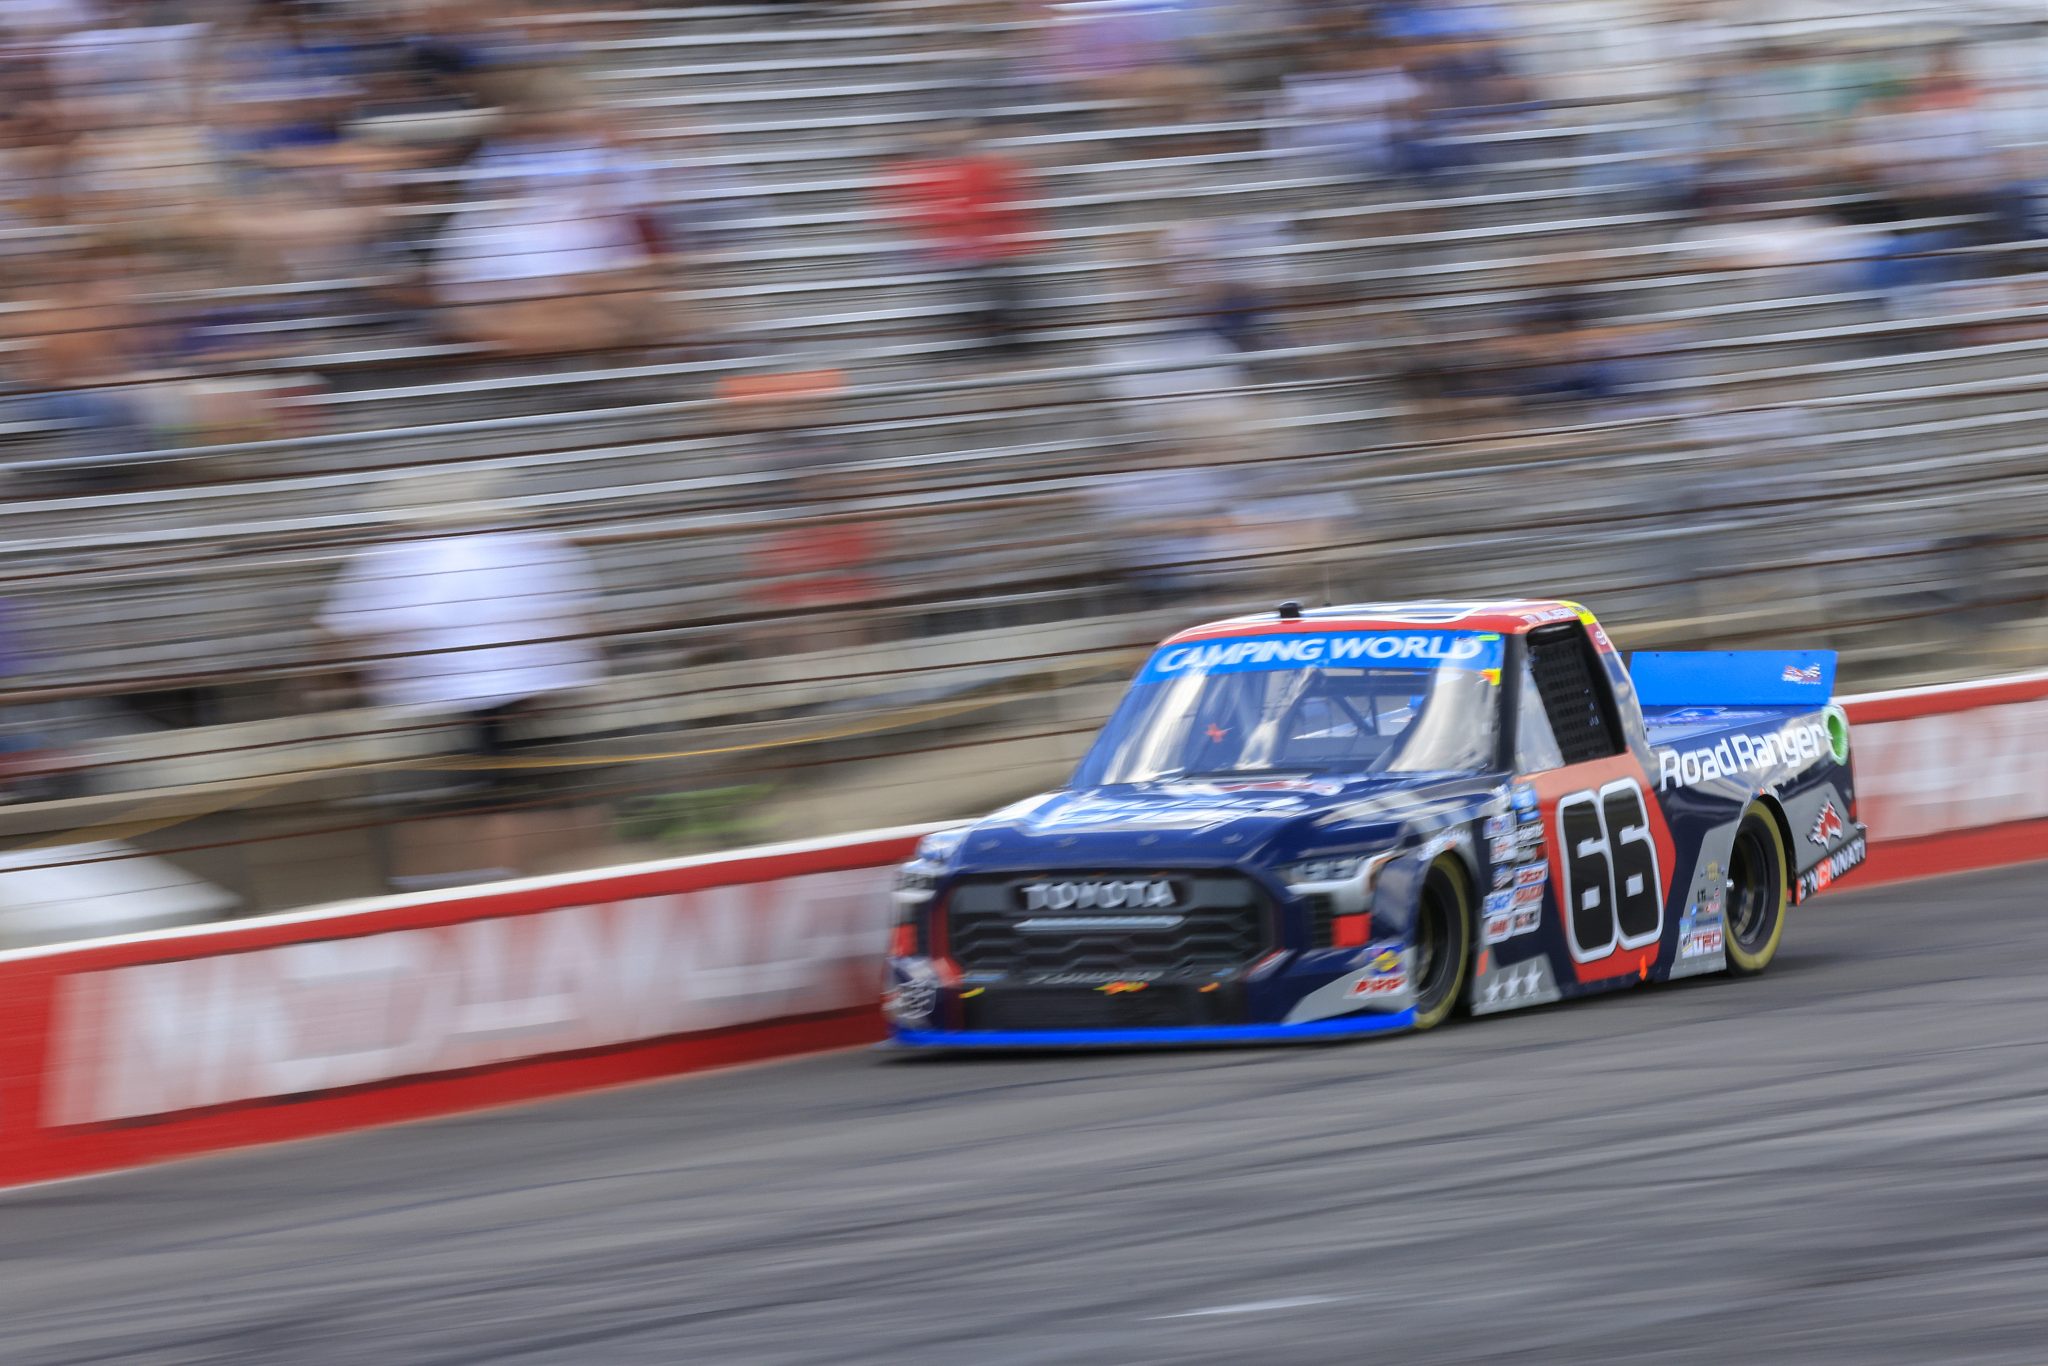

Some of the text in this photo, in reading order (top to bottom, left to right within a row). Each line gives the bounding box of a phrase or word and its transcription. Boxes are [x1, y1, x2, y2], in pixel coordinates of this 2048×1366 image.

[1155, 635, 1484, 673] CAMPING WORLD
[1658, 723, 1825, 793] Road Ranger
[1021, 879, 1177, 910] TOYOTA
[1556, 777, 1664, 963] 66
